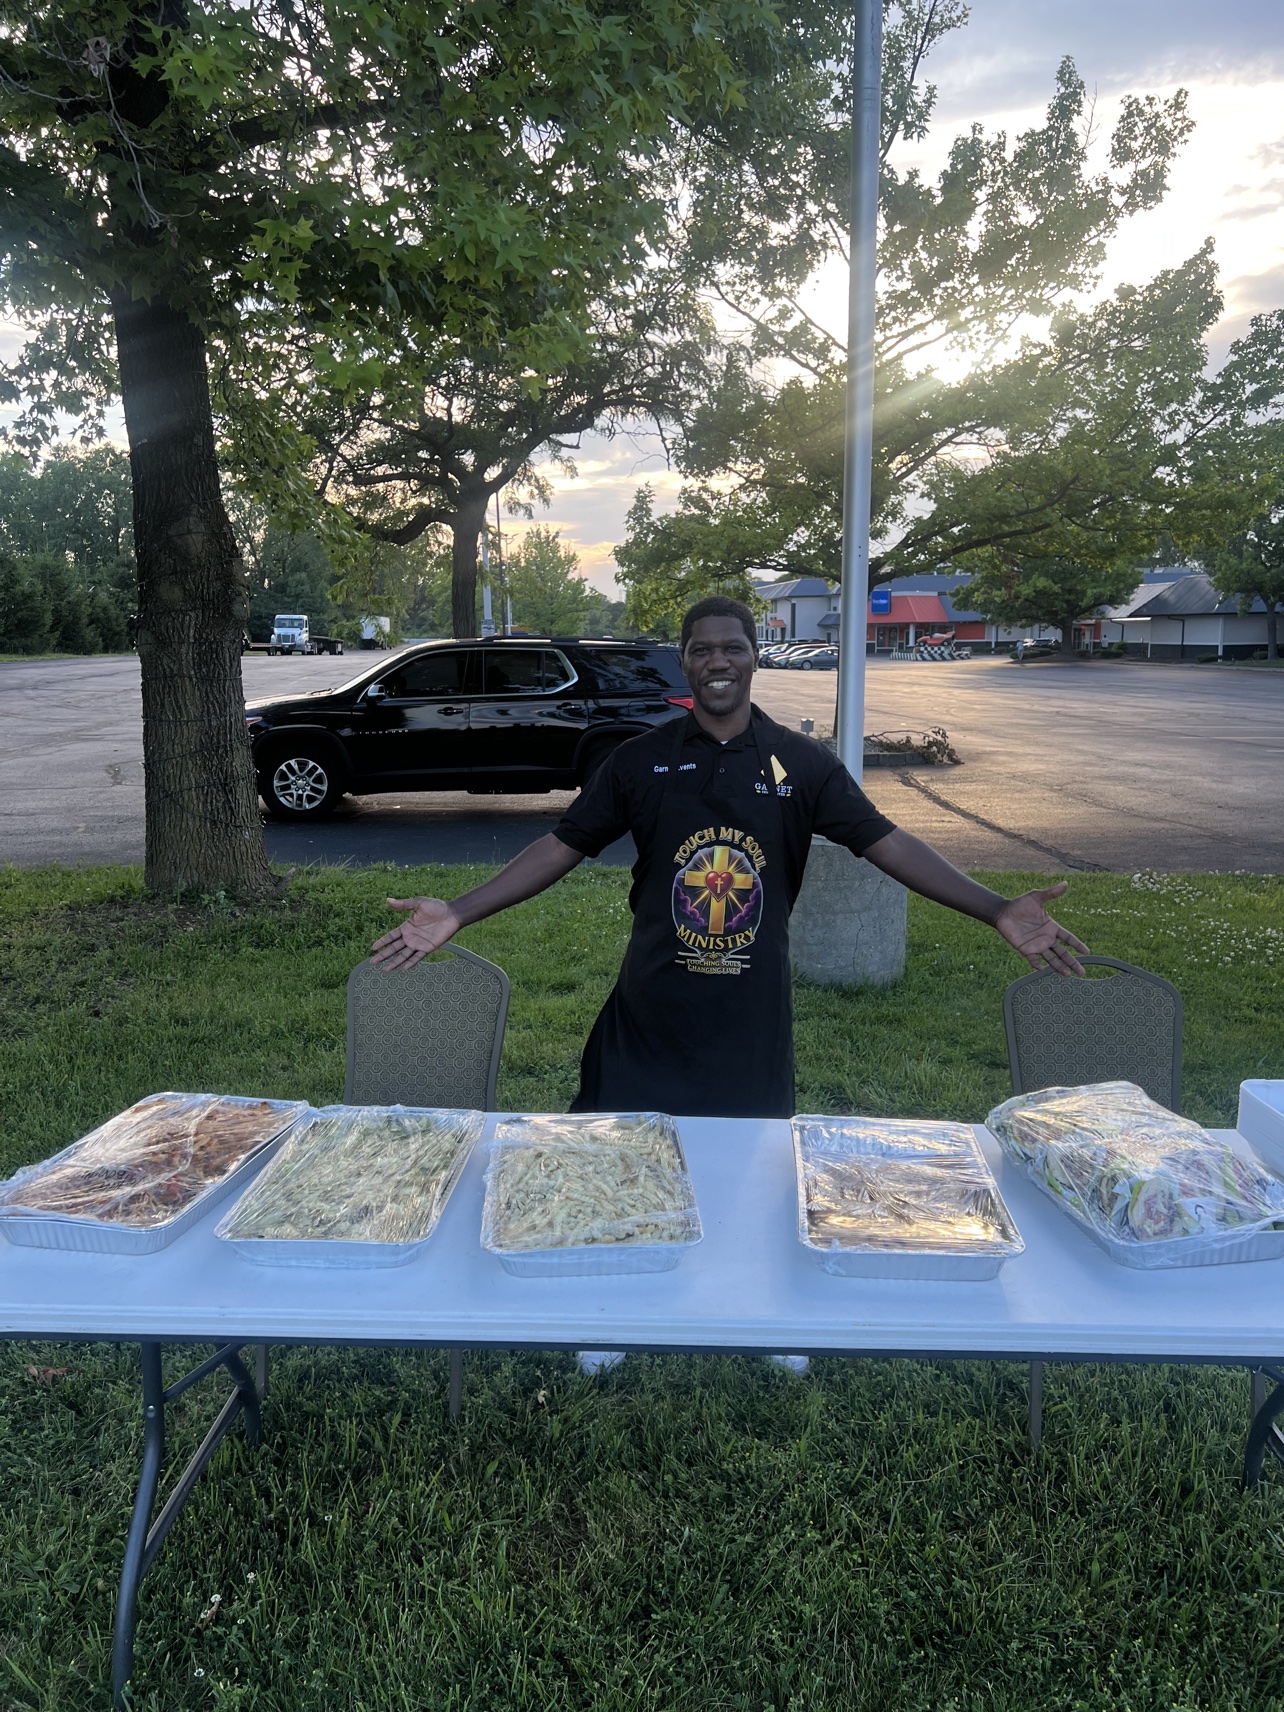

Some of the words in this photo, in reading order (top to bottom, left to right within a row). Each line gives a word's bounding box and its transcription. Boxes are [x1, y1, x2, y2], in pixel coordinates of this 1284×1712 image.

[677, 763, 697, 771] vents
[673, 826, 717, 867] TOUCH
[719, 826, 745, 845] MY
[741, 835, 767, 874] SOUL
[677, 923, 755, 950] MINISTRY
[687, 959, 720, 967] TOUCHING
